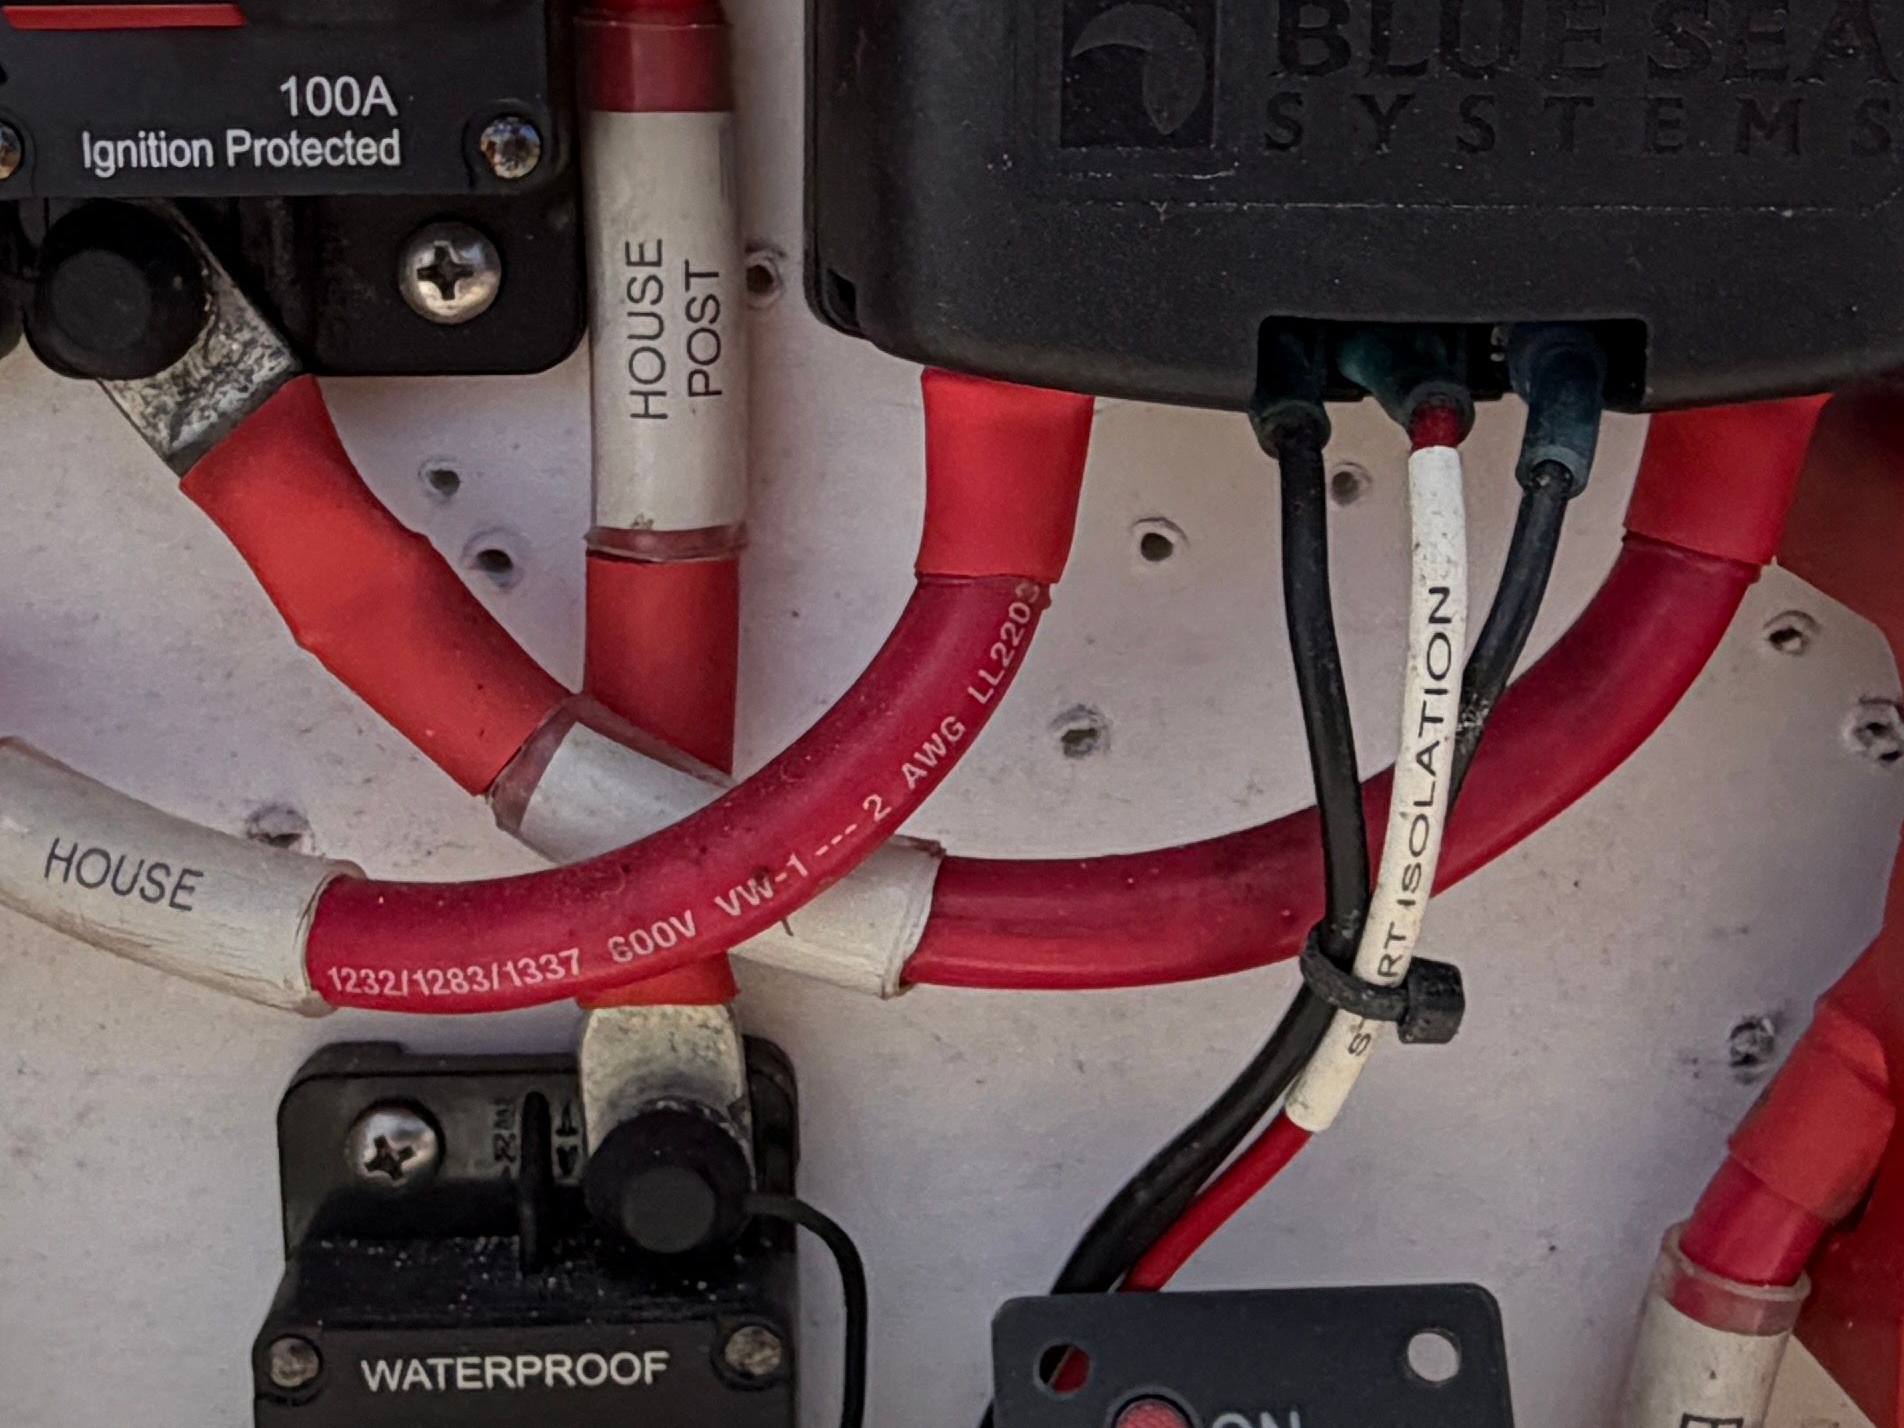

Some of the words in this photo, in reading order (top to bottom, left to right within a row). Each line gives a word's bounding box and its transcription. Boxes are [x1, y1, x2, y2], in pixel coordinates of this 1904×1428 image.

[279, 75, 398, 117] 100A
[1263, 92, 1893, 157] SYSTEMS
[82, 130, 215, 178] Ignition
[226, 128, 401, 167] Protected
[624, 238, 669, 420] HOUSE
[683, 258, 723, 398] POST
[327, 948, 581, 997] 1232/1283/1337
[607, 908, 697, 964] 600V
[712, 852, 811, 917] VW-1
[862, 793, 893, 822] 2
[901, 715, 966, 790] AWG
[1347, 920, 1407, 1057] SRT
[1396, 585, 1452, 908] ISOLATION
[44, 837, 205, 912] HOUSE
[360, 1350, 671, 1393] WATERPROOF
